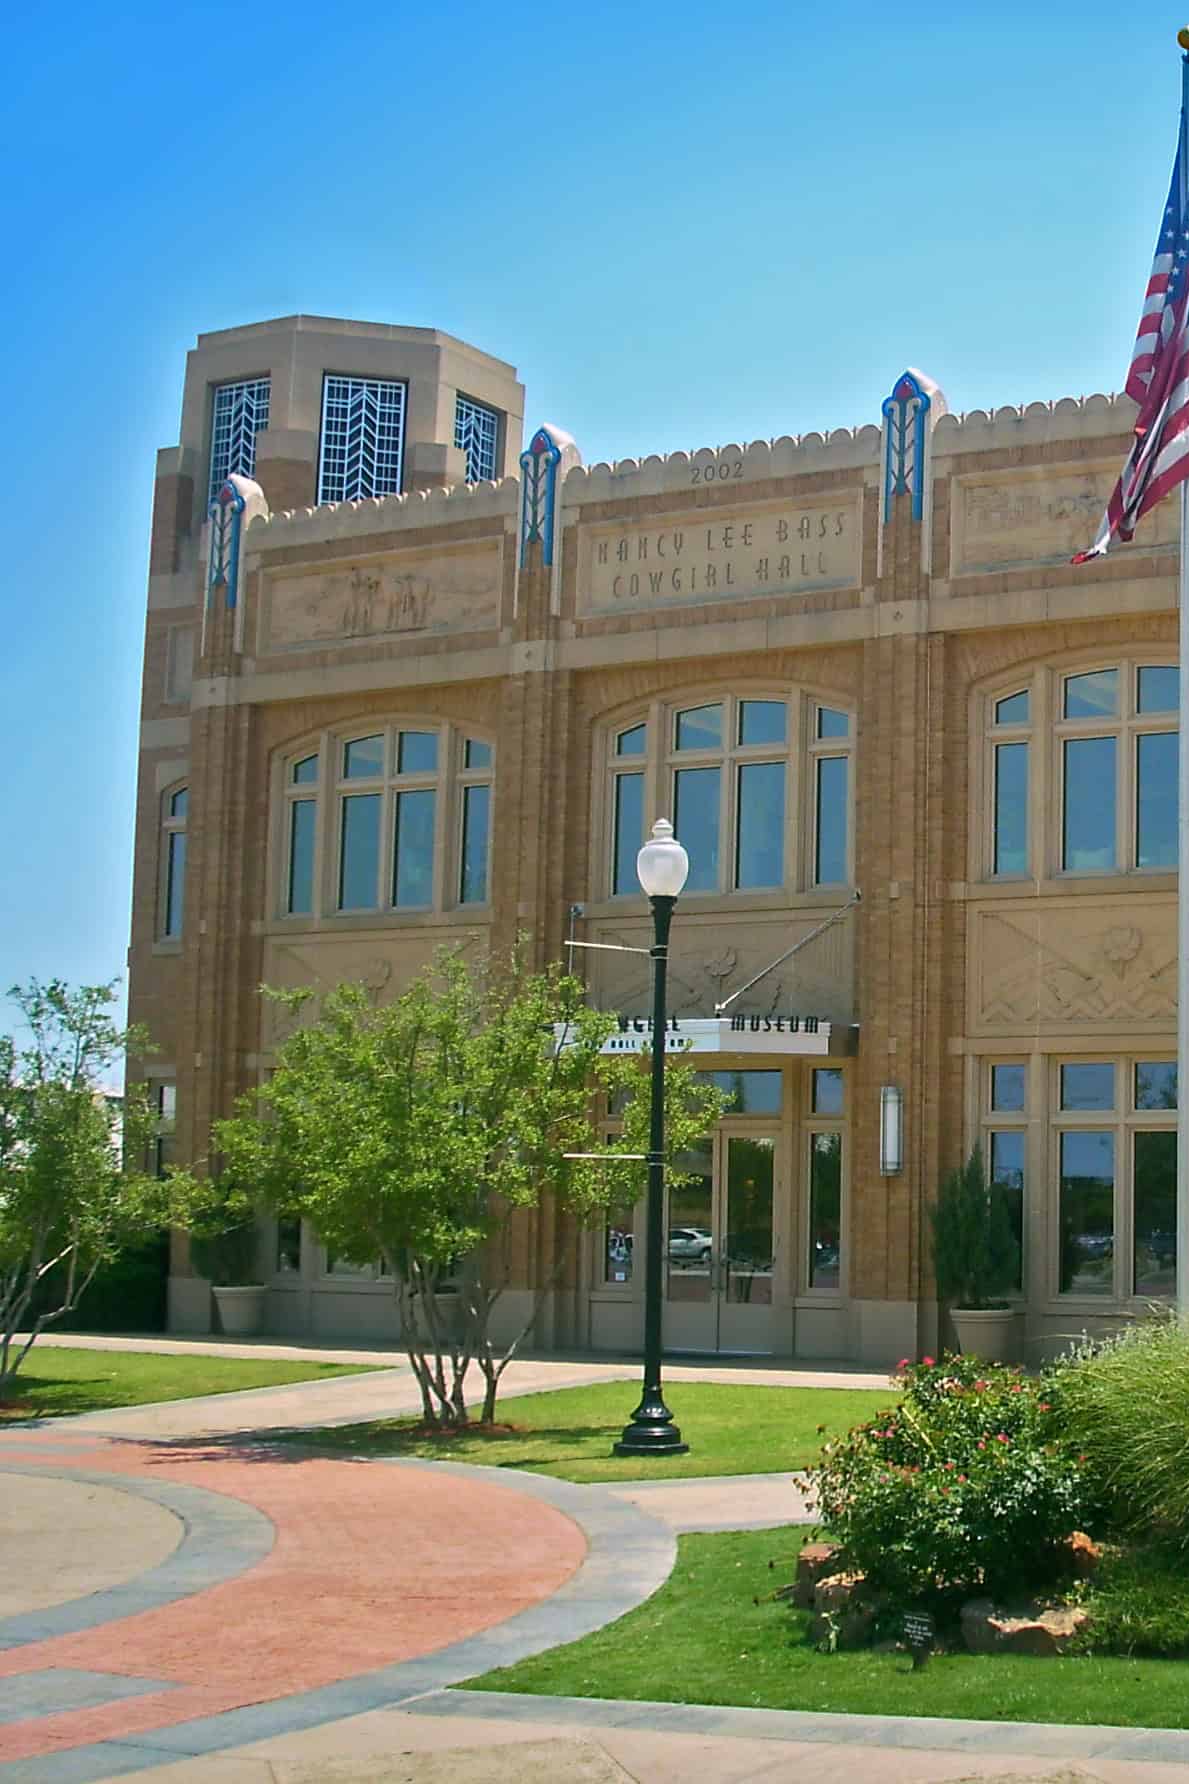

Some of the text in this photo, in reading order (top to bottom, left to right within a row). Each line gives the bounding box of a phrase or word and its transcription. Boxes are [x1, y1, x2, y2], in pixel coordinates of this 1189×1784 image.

[691, 462, 744, 484] 2002
[598, 512, 845, 564] NANCY LEE BASS
[612, 552, 827, 598] COWGIRL HALL
[730, 1014, 820, 1034] MUSEUM
